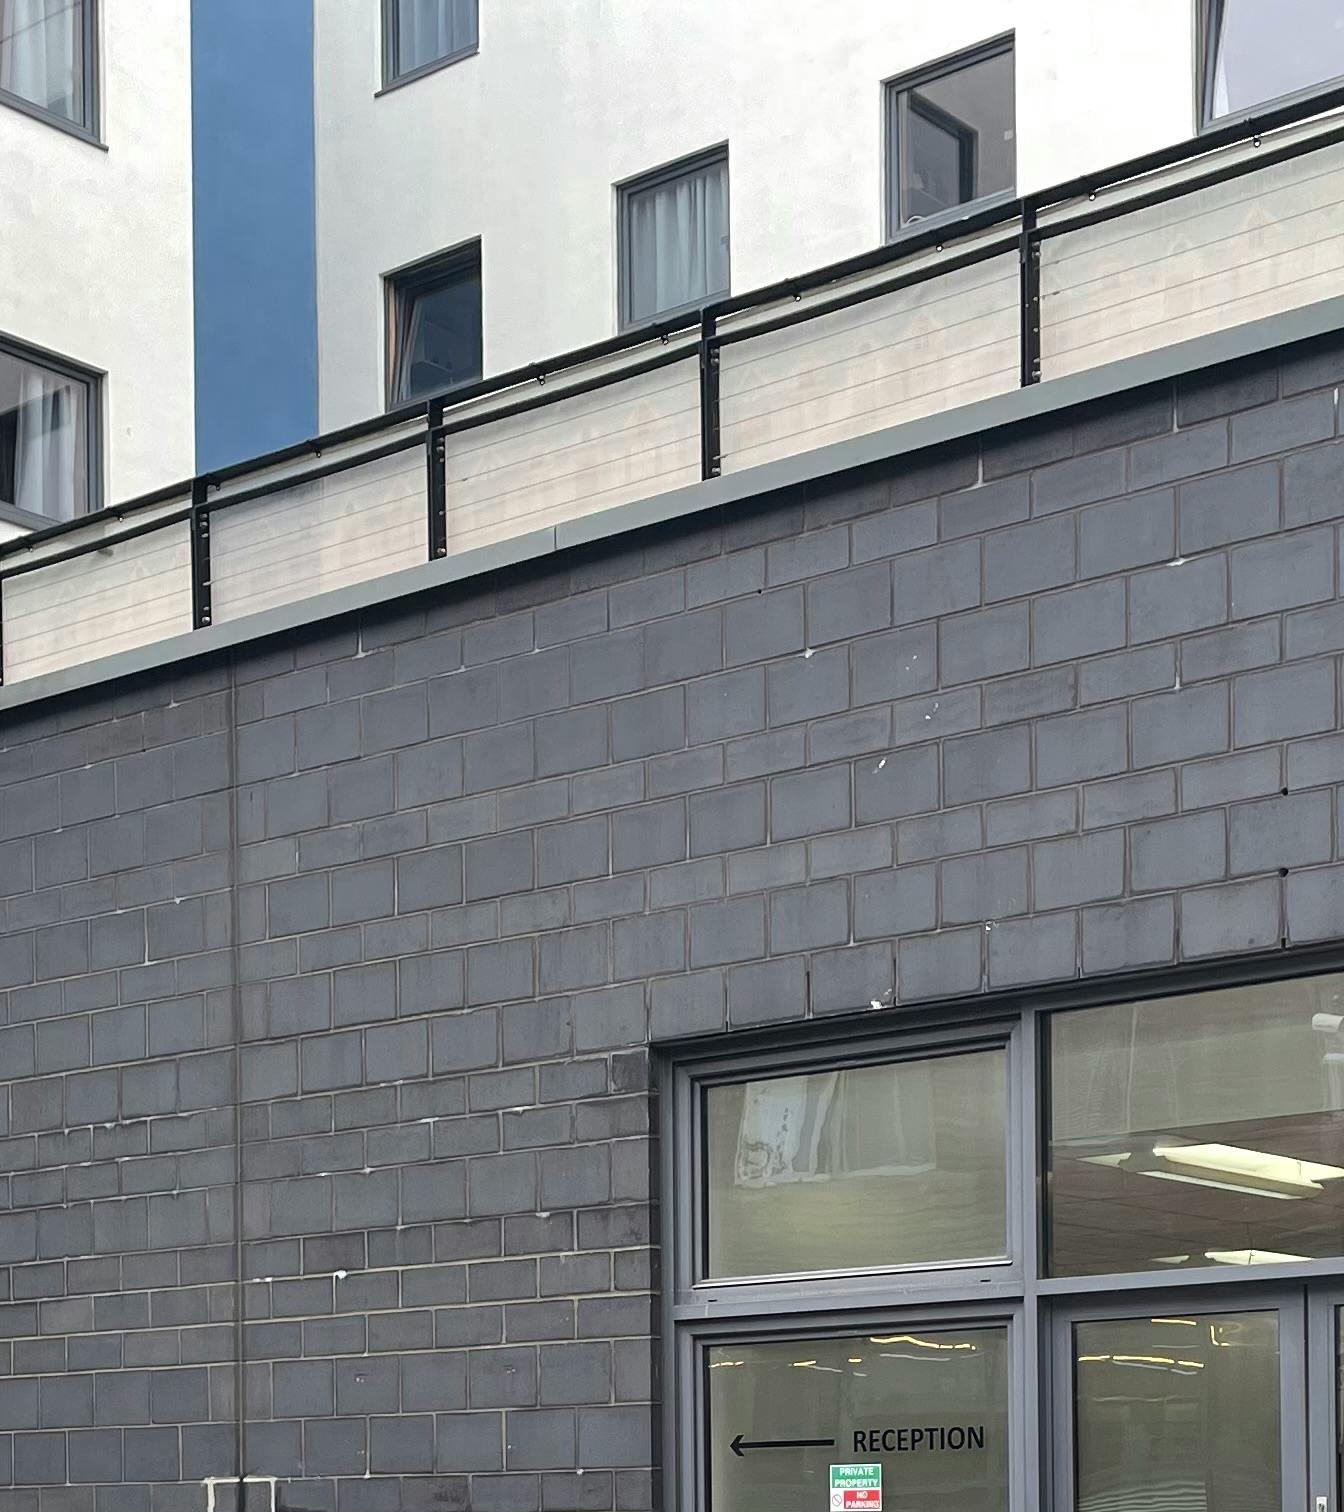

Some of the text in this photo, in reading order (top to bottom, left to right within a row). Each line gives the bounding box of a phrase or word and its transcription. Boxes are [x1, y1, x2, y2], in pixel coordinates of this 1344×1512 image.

[853, 1426, 984, 1452] RECEPTION
[840, 1467, 874, 1476] PRIVATE
[835, 1479, 878, 1488] PROPERTY
[857, 1491, 868, 1499] NO
